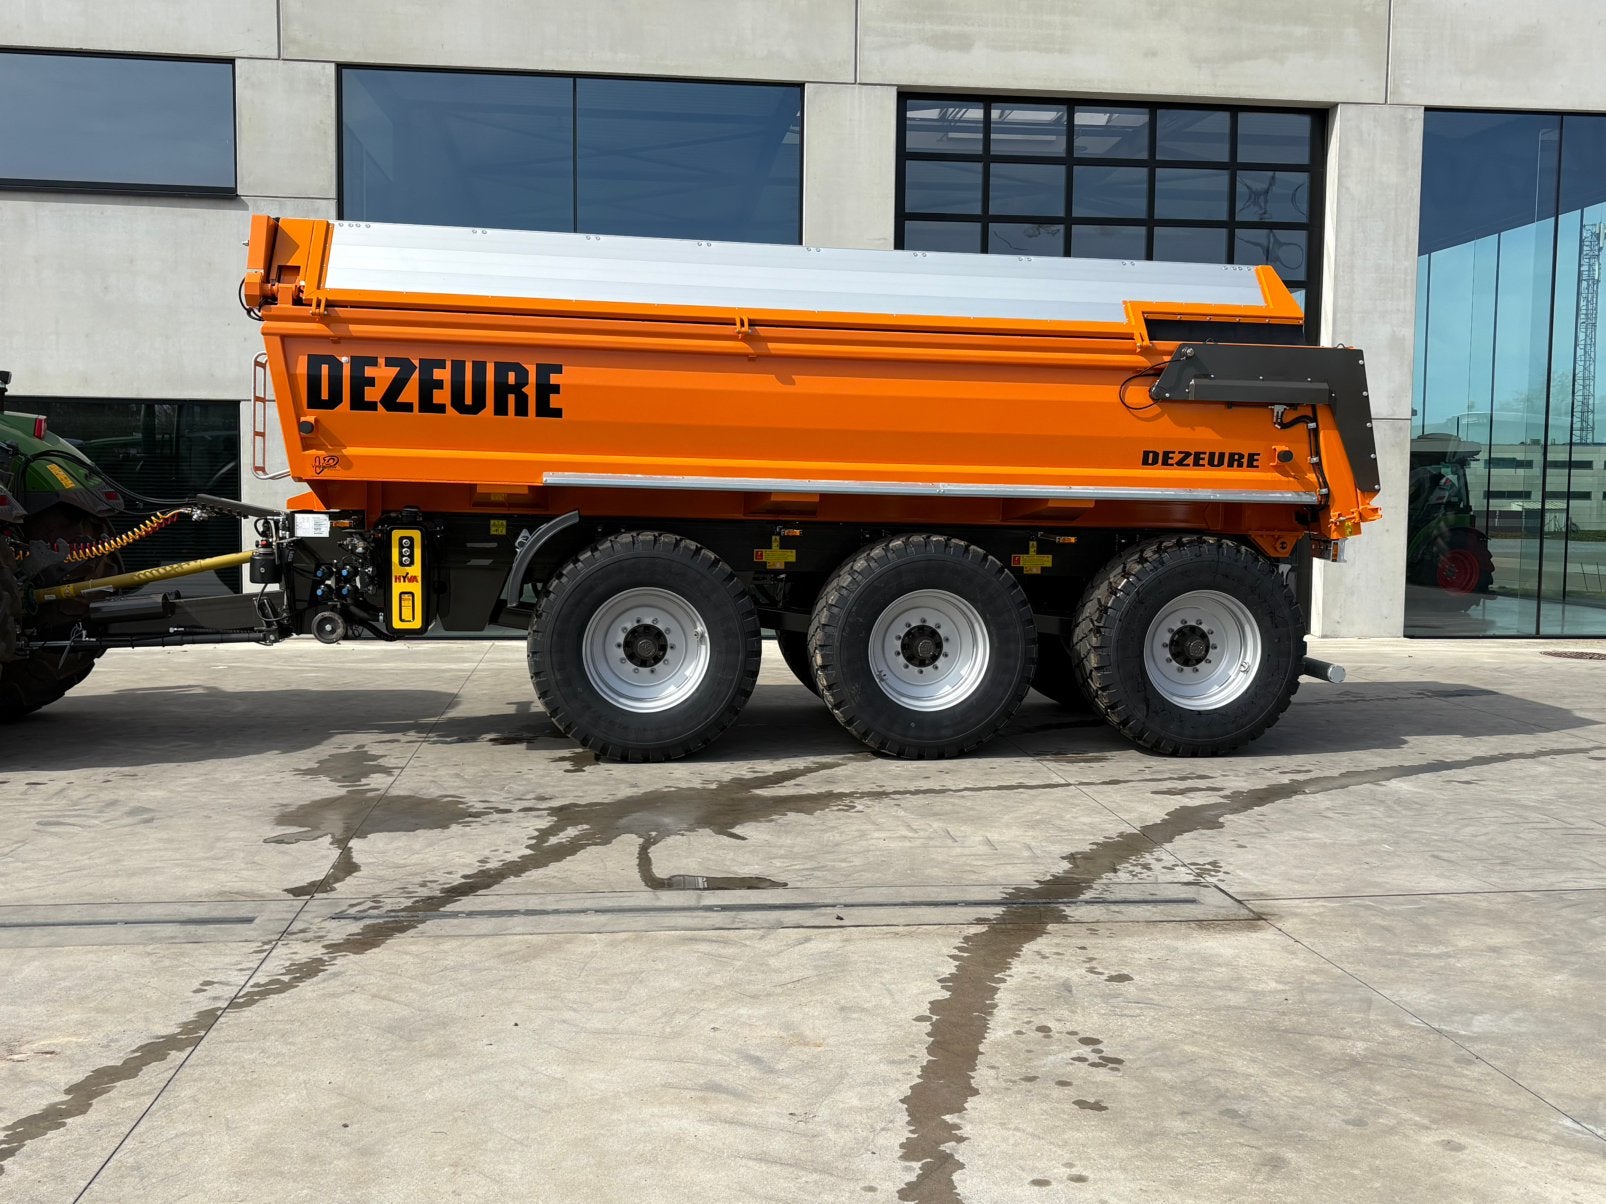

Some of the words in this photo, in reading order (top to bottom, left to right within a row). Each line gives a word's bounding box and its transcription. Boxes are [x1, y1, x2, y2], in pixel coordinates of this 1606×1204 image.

[307, 354, 563, 418] DEZEURE
[1141, 450, 1261, 468] DEZEURE
[394, 572, 420, 583] HYVA
